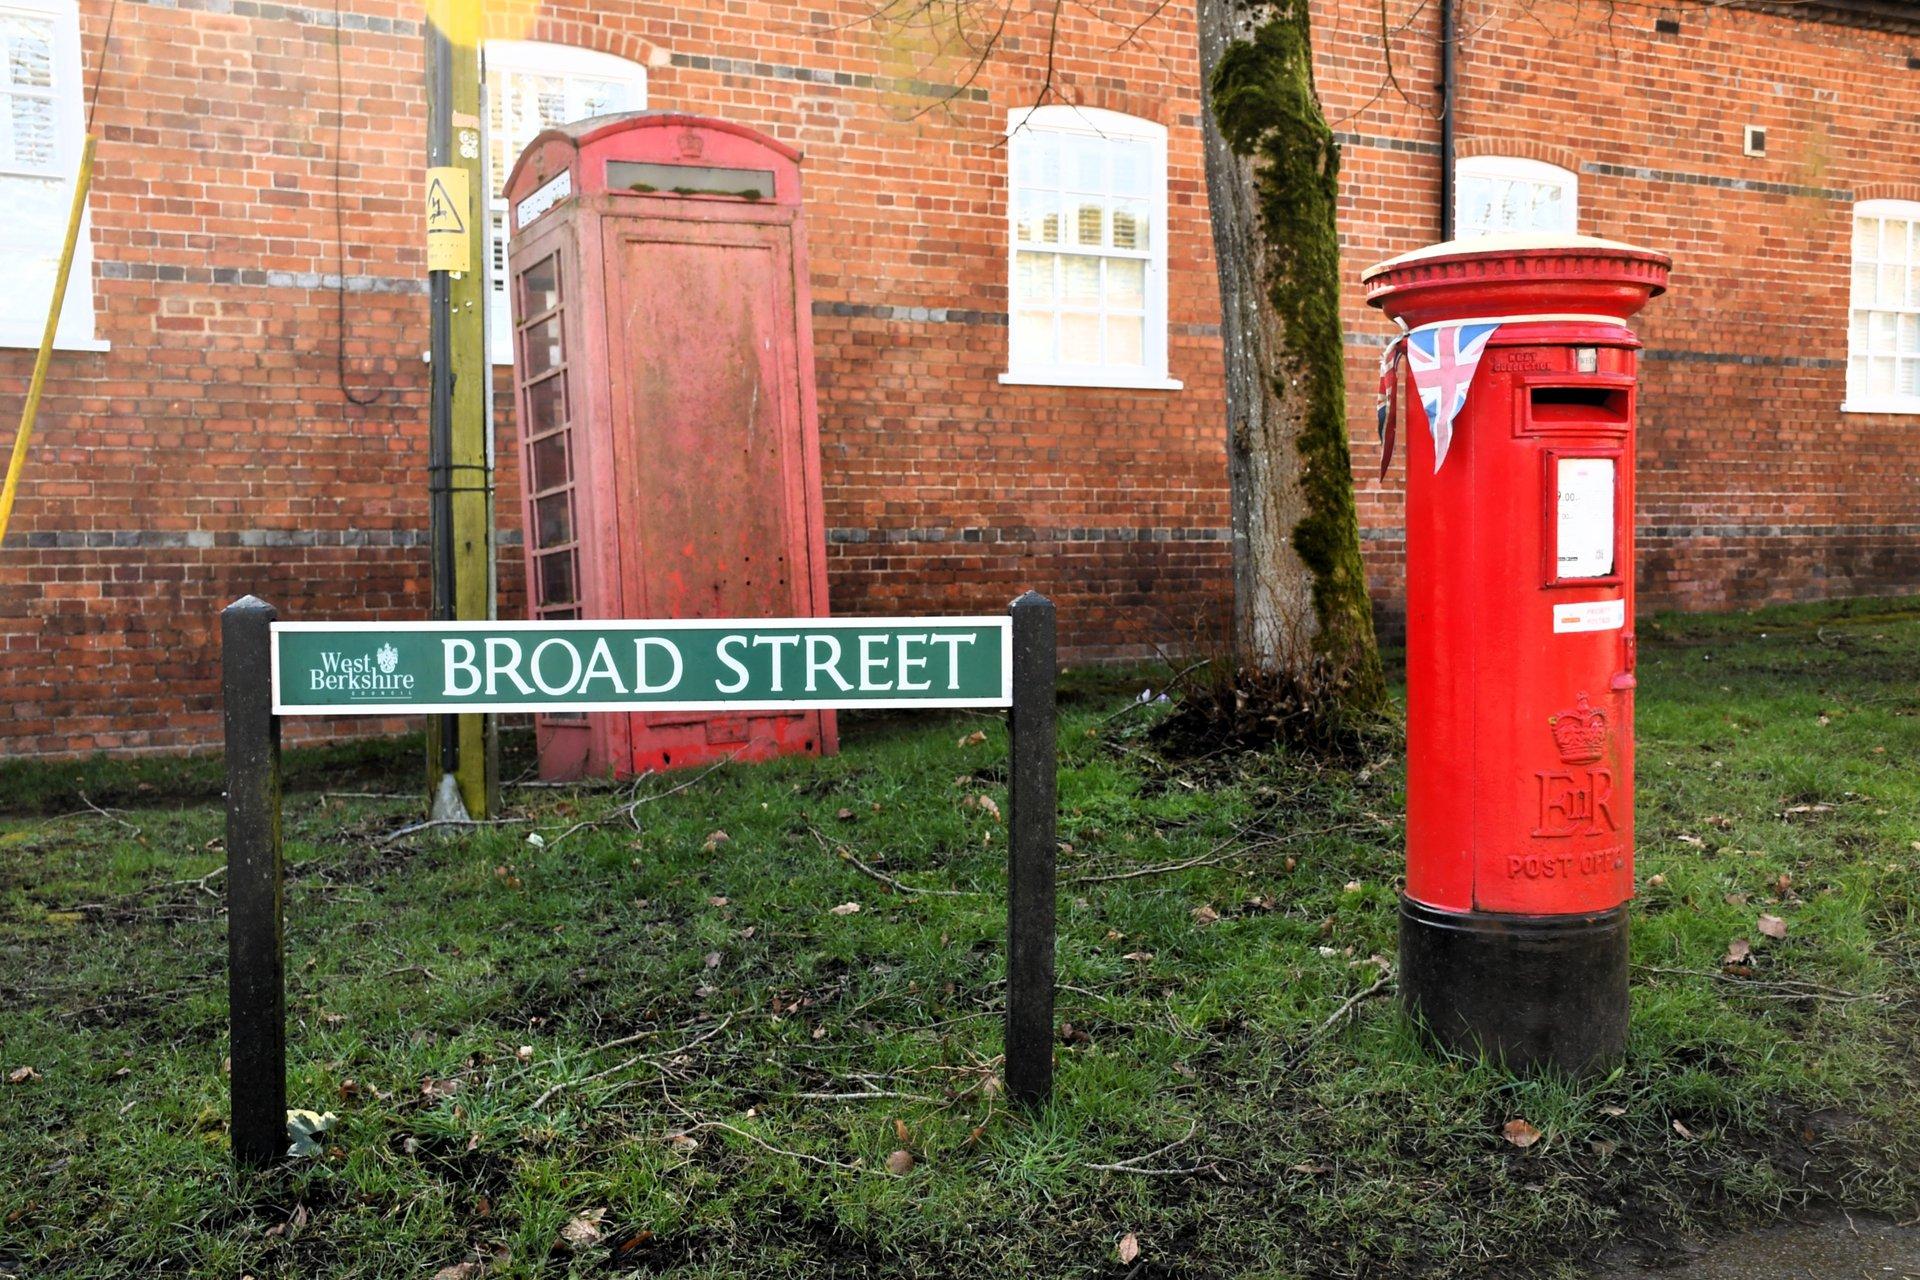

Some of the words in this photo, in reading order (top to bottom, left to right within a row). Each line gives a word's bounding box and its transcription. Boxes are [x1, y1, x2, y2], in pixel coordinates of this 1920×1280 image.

[320, 652, 371, 673] West
[441, 637, 684, 696] BROAD
[715, 632, 977, 693] STREET
[309, 667, 415, 690] Berkshire
[1507, 854, 1574, 879] POST
